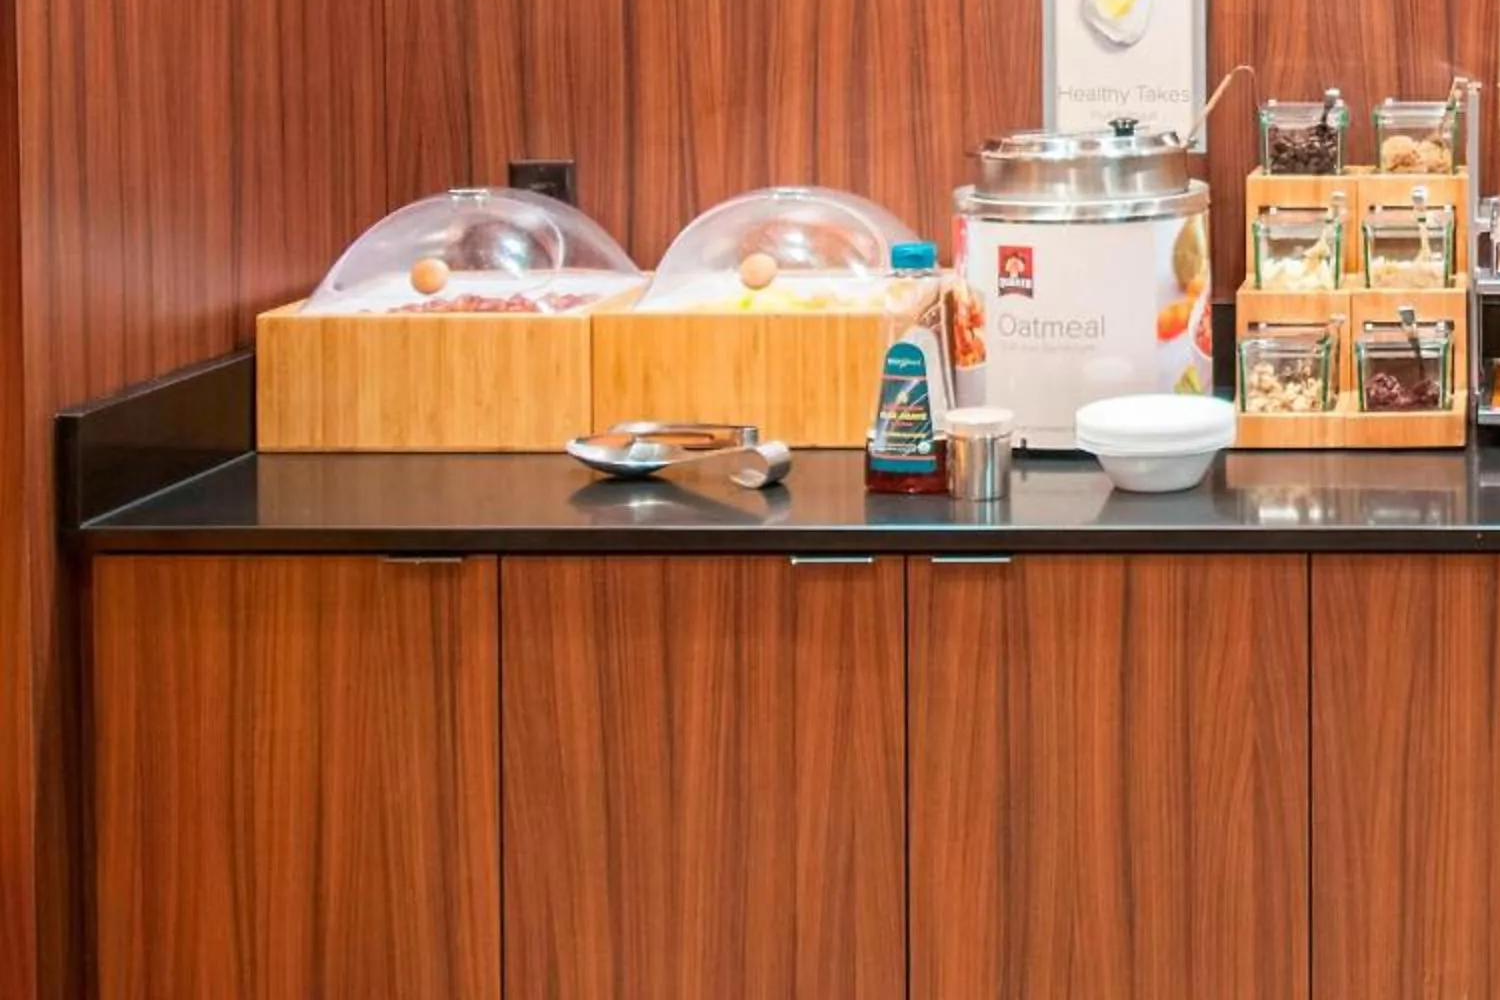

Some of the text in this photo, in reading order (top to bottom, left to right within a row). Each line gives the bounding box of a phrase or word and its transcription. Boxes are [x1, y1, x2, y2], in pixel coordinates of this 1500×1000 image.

[1058, 85, 1190, 105] Healthy Takes
[998, 313, 1105, 339] Oatmeal
